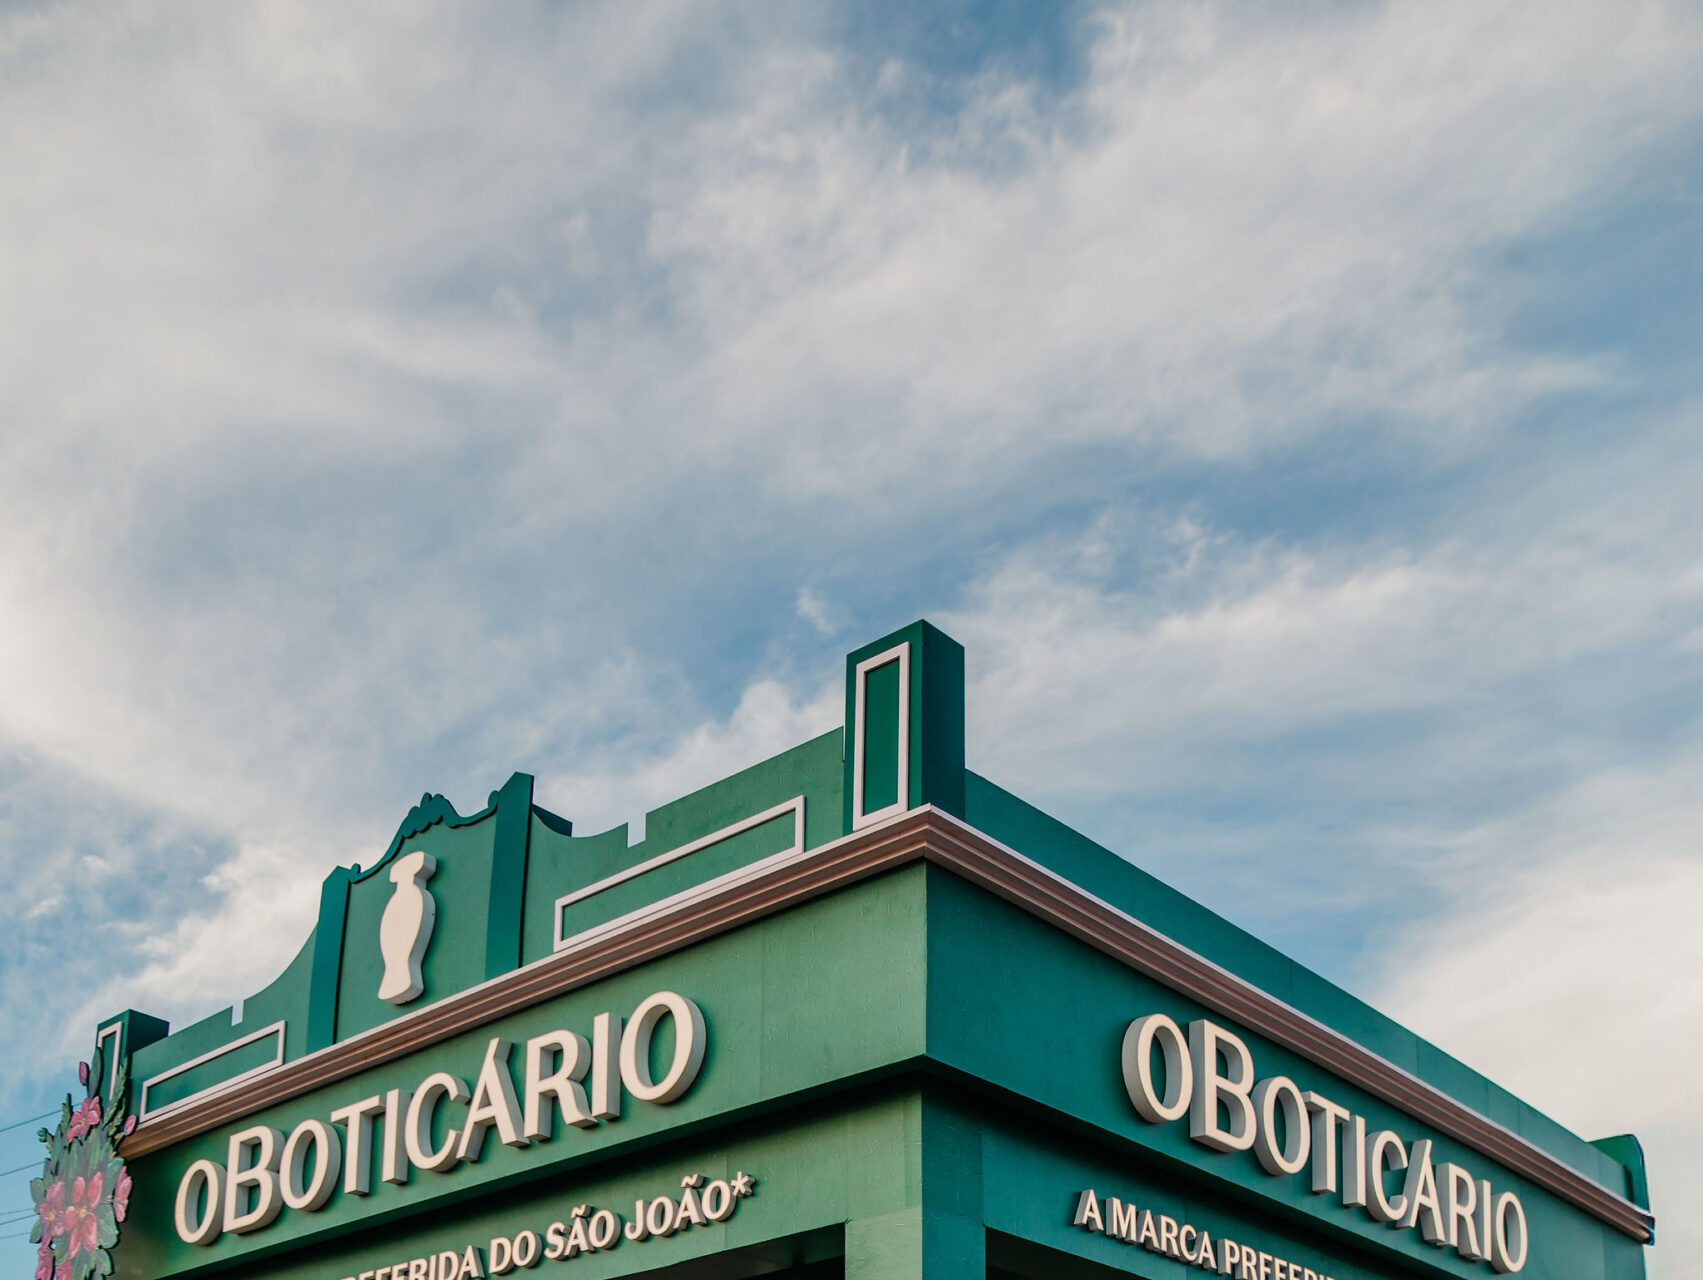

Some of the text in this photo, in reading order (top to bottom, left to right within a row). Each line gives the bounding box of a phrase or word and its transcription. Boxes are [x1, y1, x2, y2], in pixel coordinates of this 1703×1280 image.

[488, 1230, 543, 1275] DO
[544, 1203, 621, 1260] SÃO
[1073, 1188, 1104, 1232] A
[1105, 1196, 1217, 1270] MARCA
